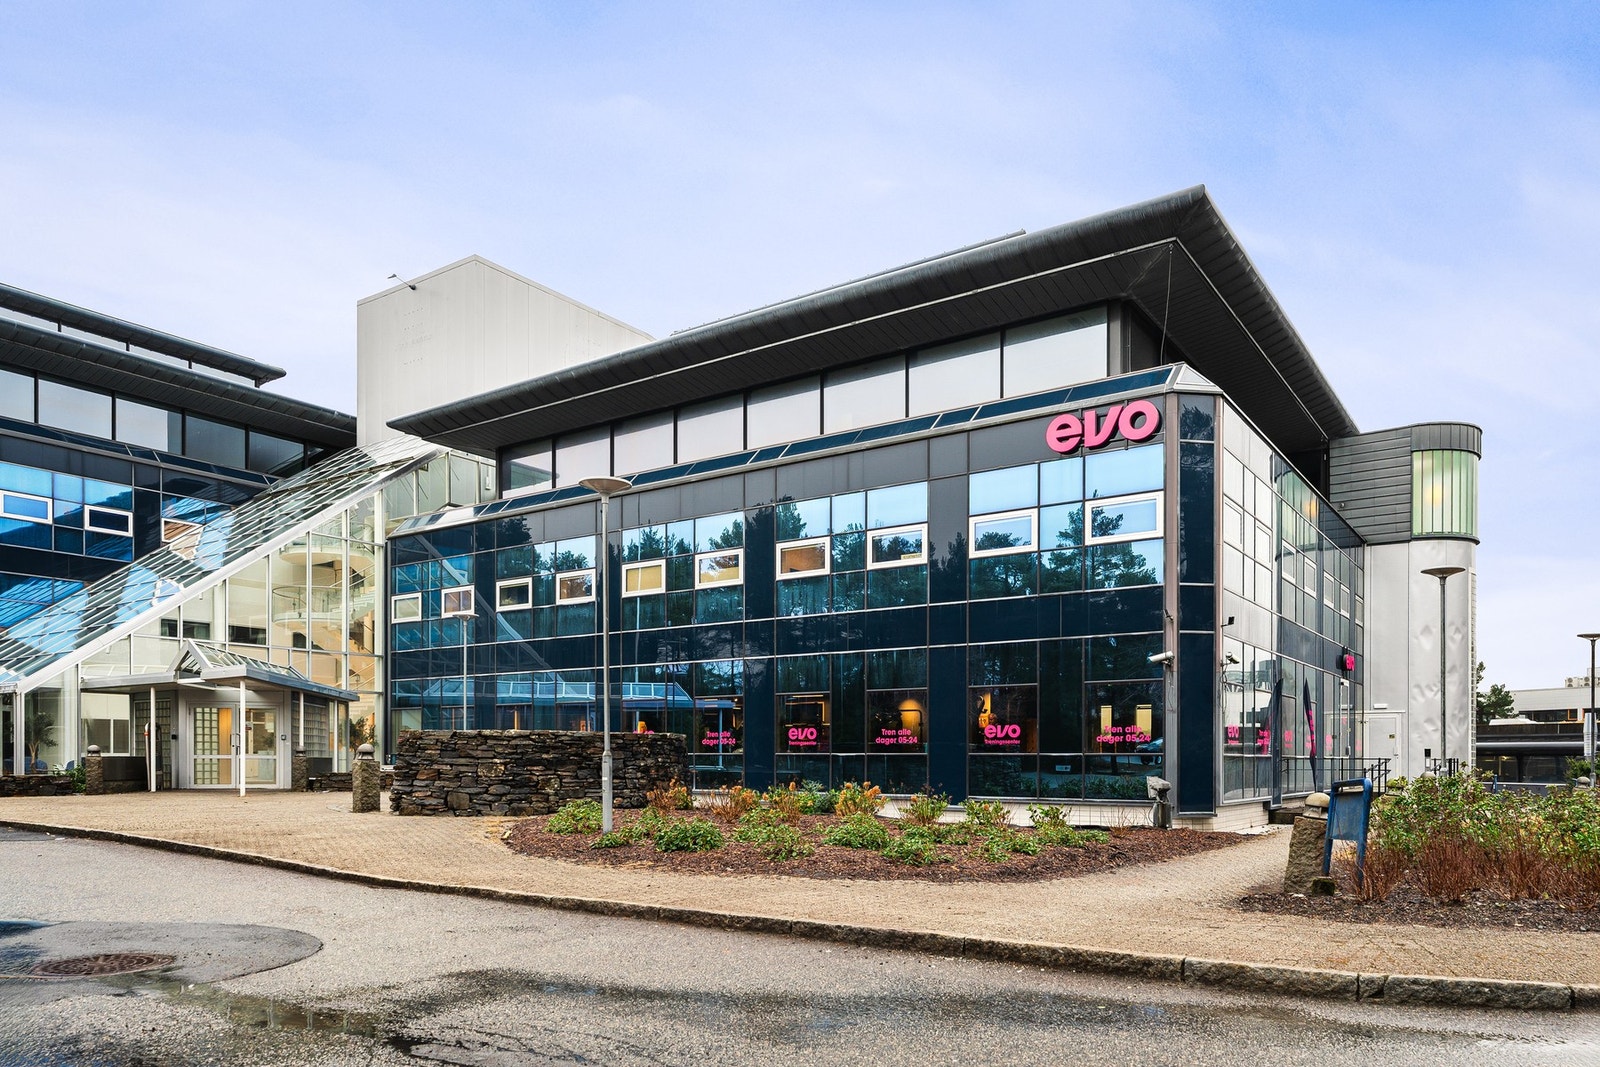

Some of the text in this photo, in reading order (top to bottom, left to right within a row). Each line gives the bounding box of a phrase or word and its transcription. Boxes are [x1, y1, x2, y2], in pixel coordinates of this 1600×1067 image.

[1045, 399, 1161, 455] evo
[788, 727, 817, 740] evo
[881, 728, 912, 736] Tren alle
[984, 724, 1021, 738] evo
[1104, 725, 1142, 733] Tren alle
[875, 736, 918, 746] dager 05-24
[1096, 733, 1151, 744] dager 05-24
